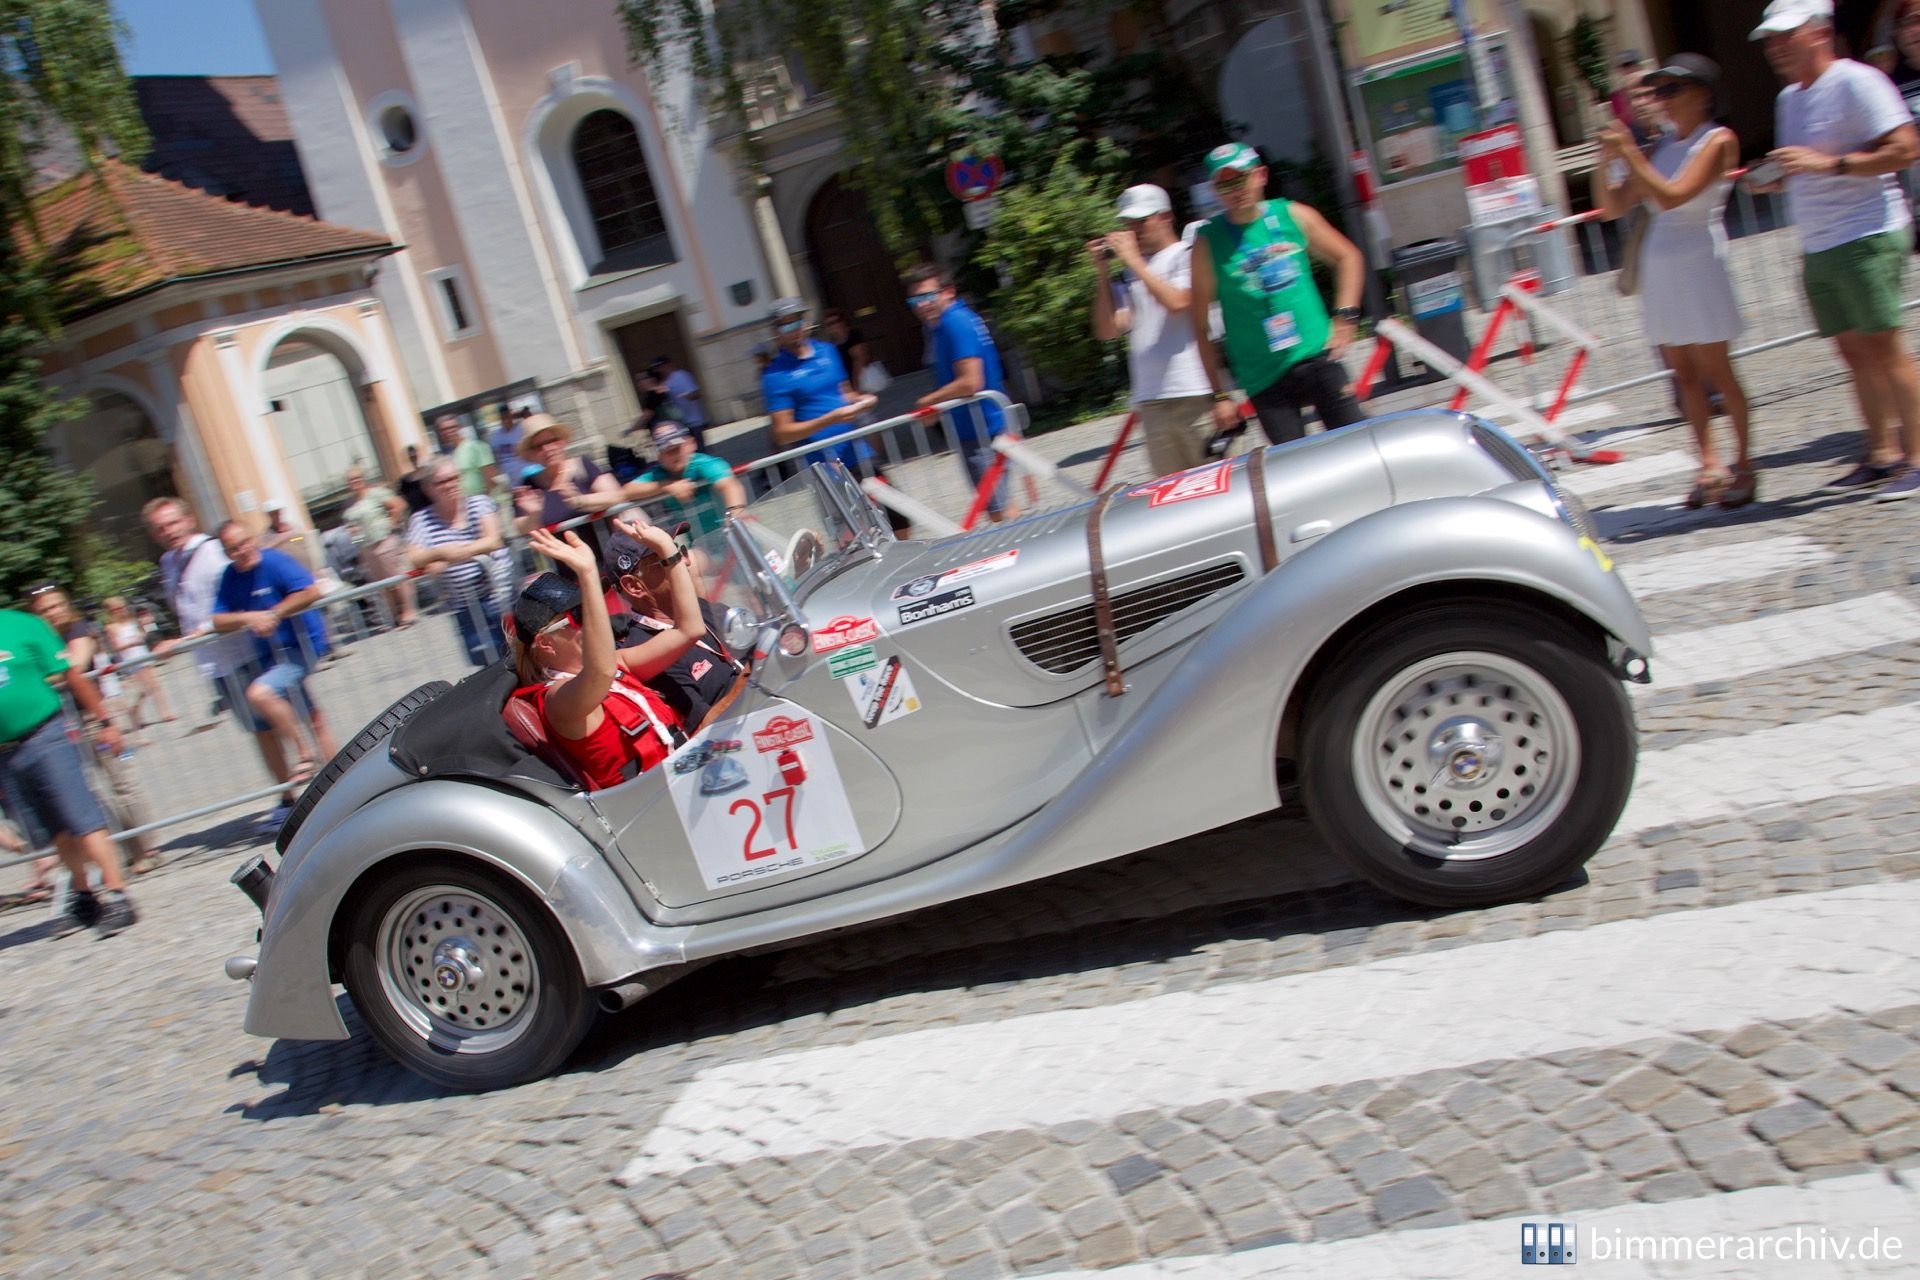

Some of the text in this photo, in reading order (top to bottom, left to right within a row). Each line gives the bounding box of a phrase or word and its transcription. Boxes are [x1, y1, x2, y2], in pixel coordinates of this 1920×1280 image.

[901, 596, 974, 624] Bonhams
[729, 786, 798, 861] 27
[717, 857, 804, 884] PORSCHE
